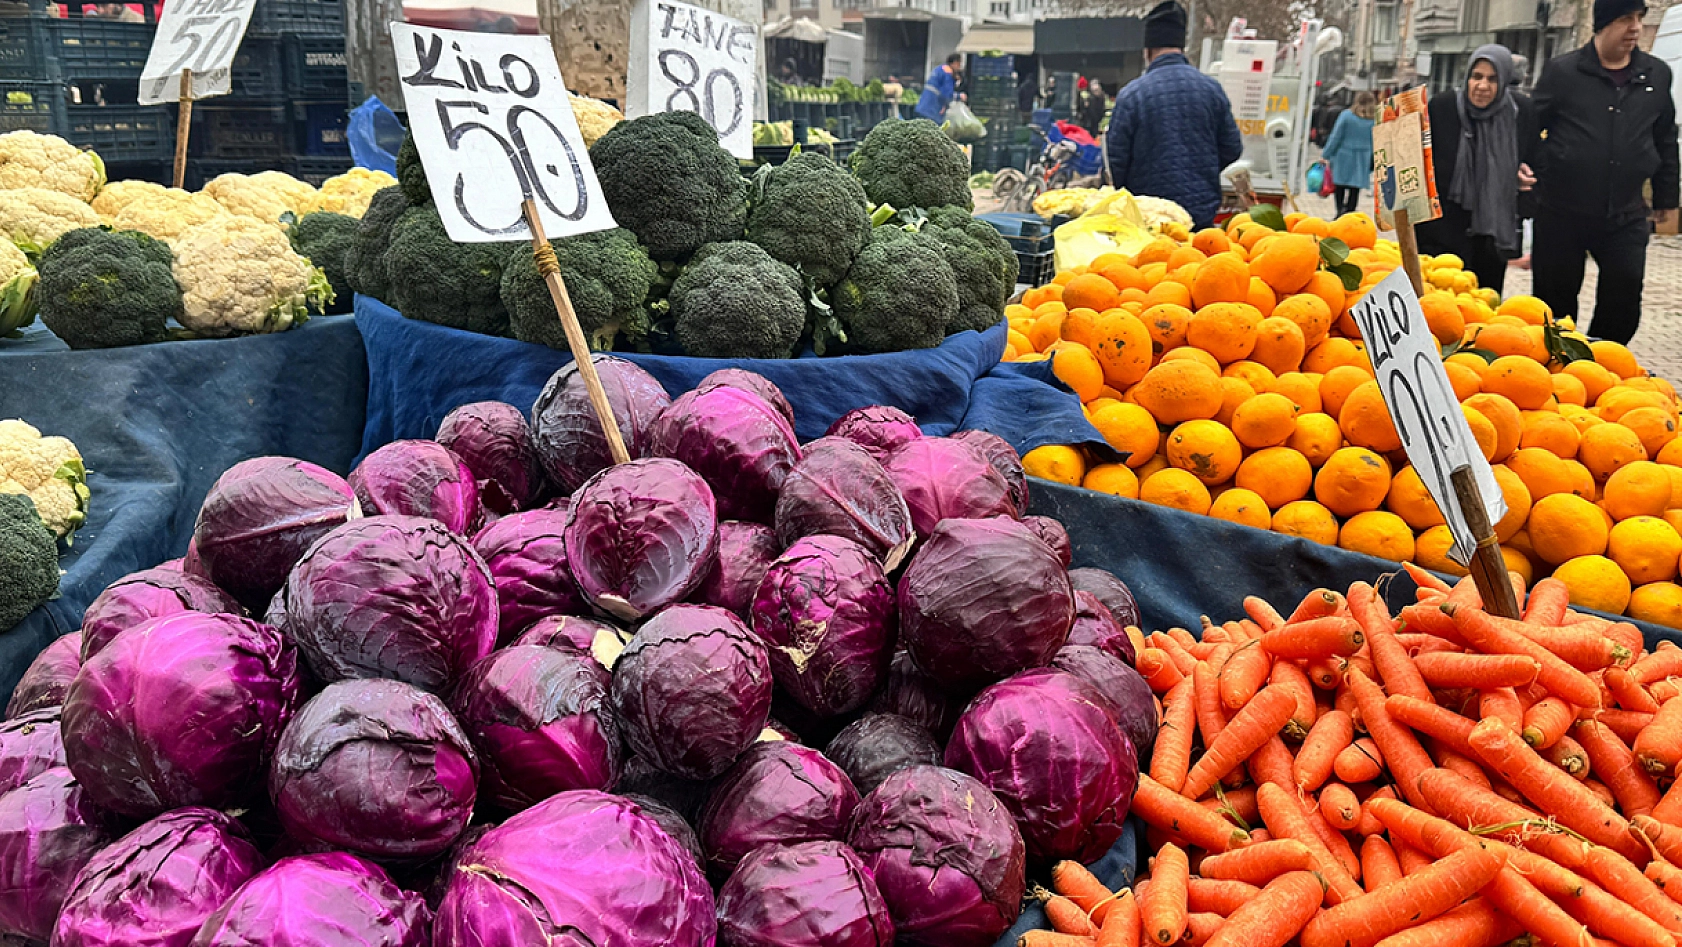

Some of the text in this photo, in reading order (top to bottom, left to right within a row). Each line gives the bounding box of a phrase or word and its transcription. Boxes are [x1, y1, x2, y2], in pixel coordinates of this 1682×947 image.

[150, 16, 241, 99] 50
[658, 3, 756, 64] TANE
[658, 48, 744, 138] 80
[435, 98, 588, 235] 50
